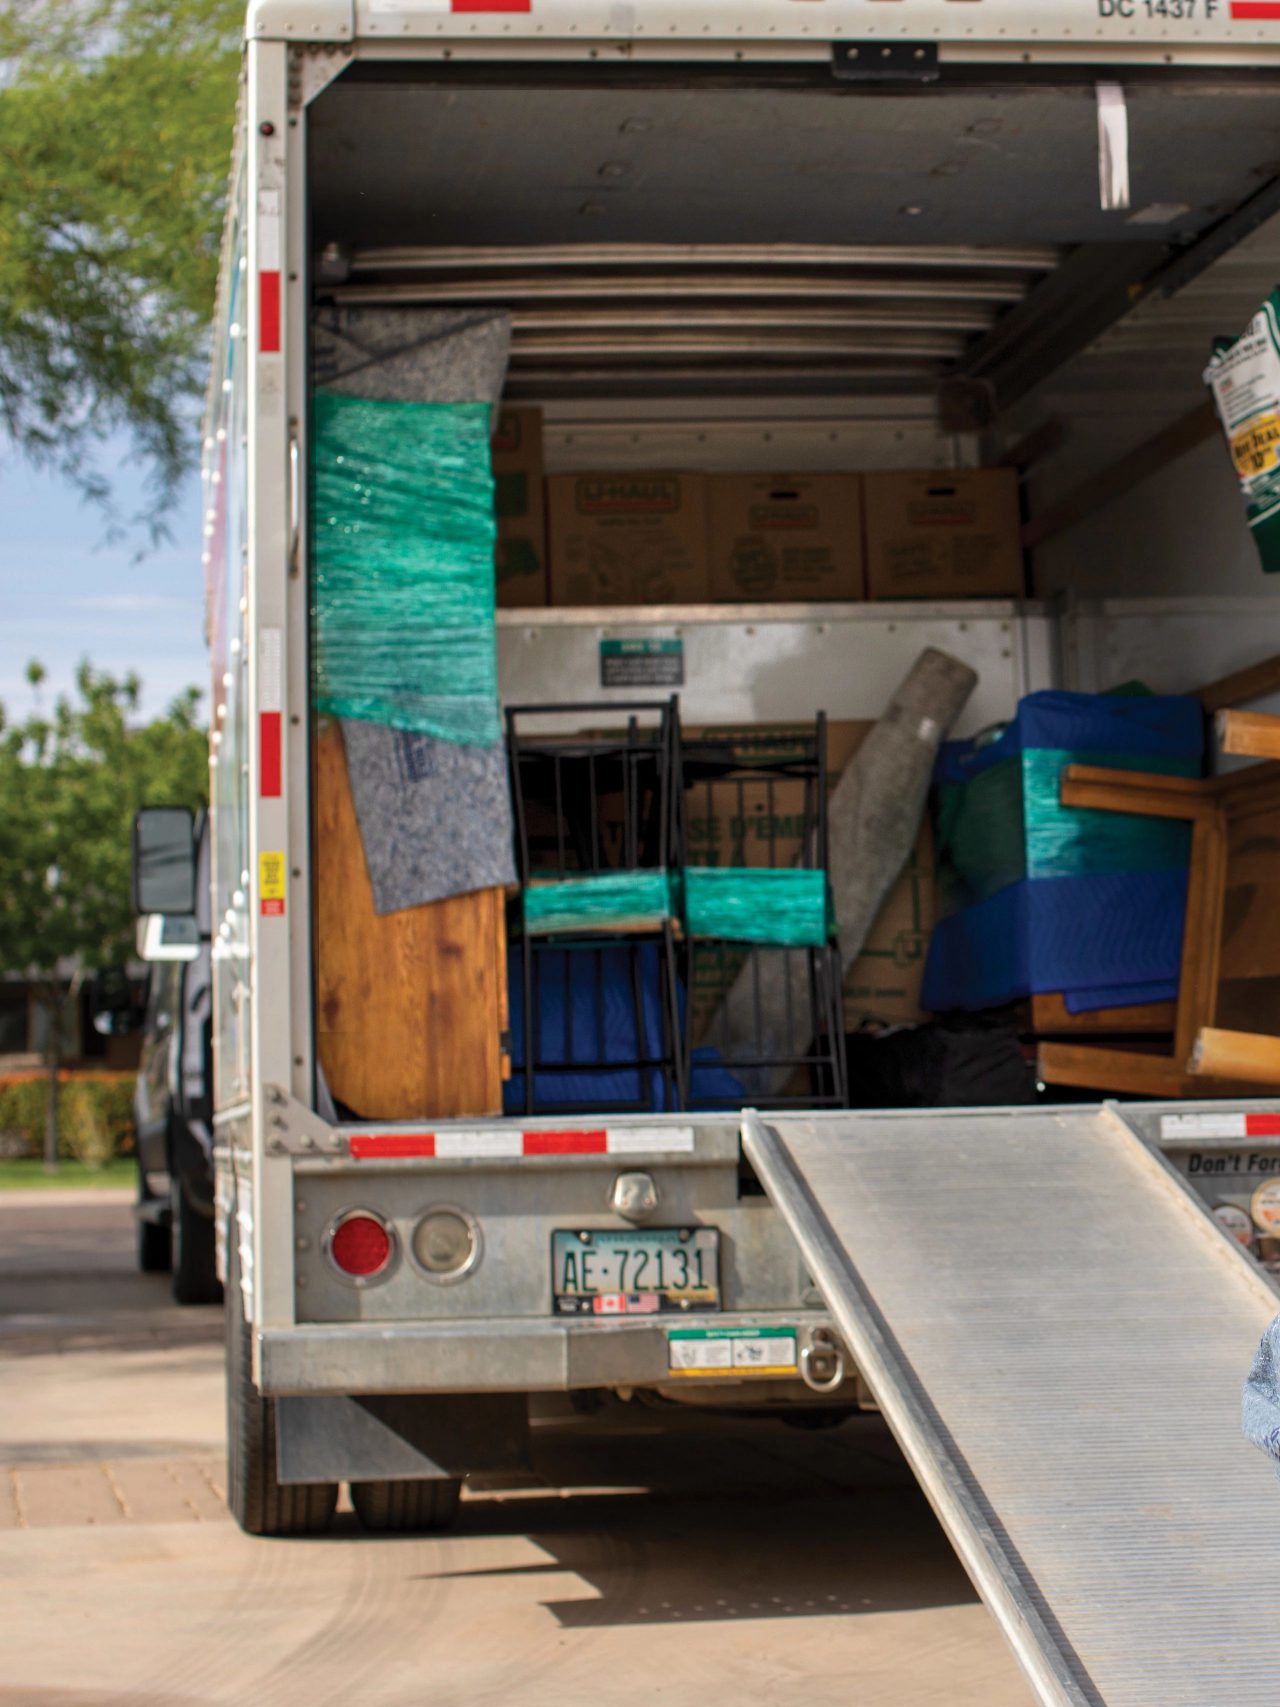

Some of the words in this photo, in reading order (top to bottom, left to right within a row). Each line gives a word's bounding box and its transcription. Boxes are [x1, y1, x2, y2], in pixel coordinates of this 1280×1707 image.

[1098, 0, 1135, 18] DC
[1143, 0, 1196, 19] 1437
[1205, 0, 1218, 19] F
[1188, 1153, 1241, 1173] Don't
